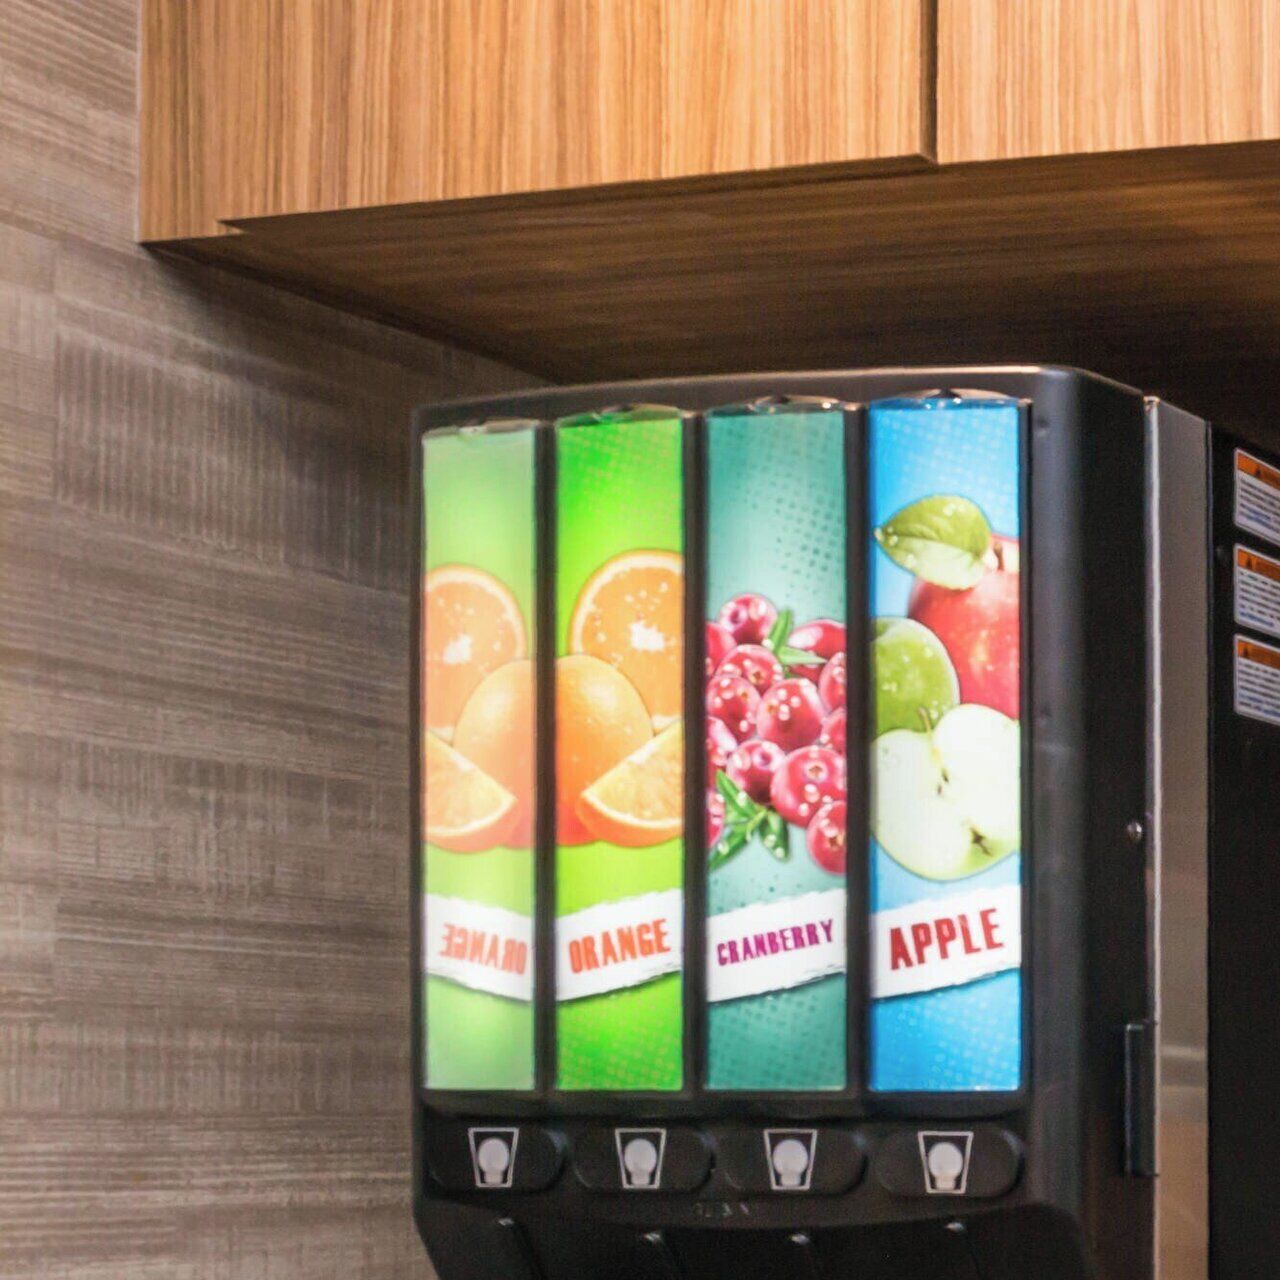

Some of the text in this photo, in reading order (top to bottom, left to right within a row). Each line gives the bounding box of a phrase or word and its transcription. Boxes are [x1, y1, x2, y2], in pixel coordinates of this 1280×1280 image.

[568, 918, 671, 974] ORANGE
[717, 919, 834, 966] CRANBERRY
[890, 908, 1004, 970] APPLE
